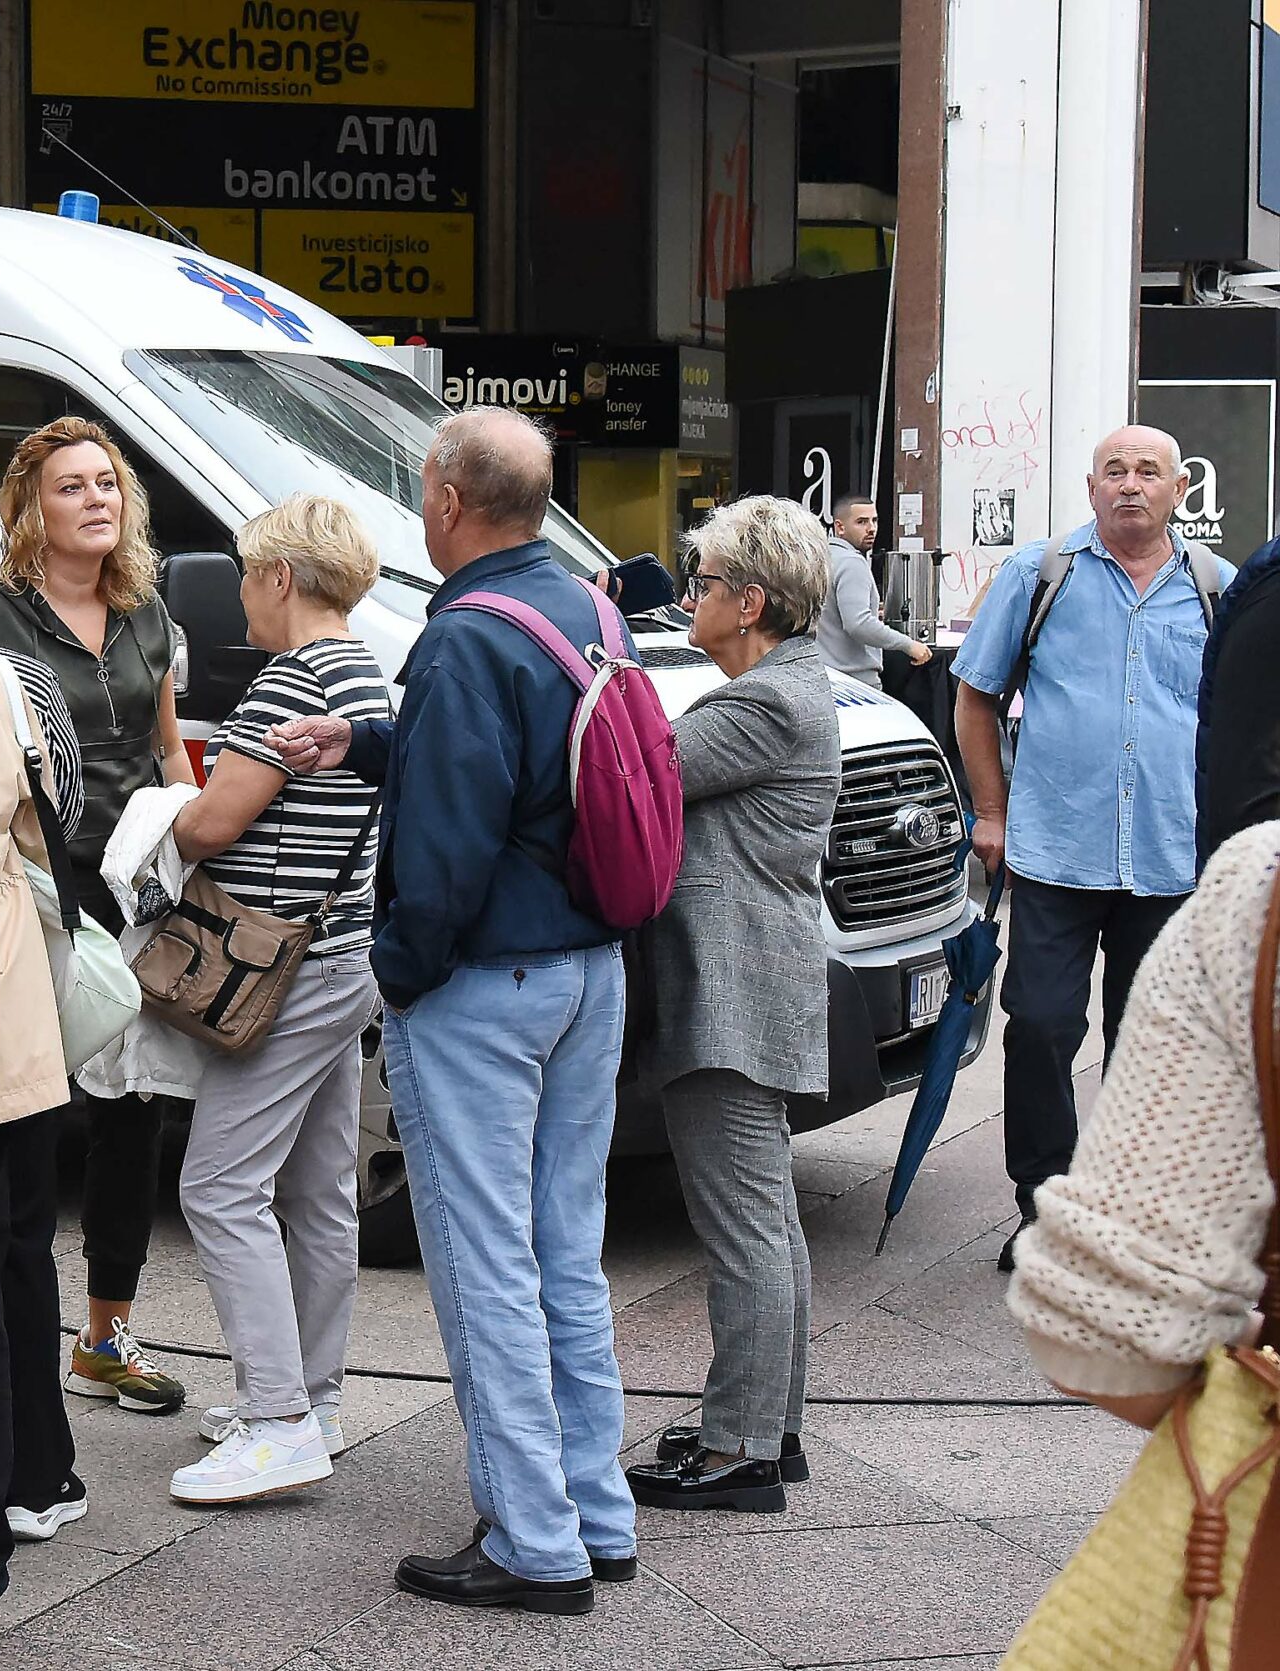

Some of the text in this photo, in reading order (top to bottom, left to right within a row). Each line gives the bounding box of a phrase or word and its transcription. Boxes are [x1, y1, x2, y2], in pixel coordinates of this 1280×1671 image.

[242, 1, 361, 40] Money
[143, 27, 369, 85] Exchange
[156, 75, 312, 97] No Commission
[41, 104, 73, 118] 24/7
[337, 116, 438, 157] ATM
[225, 159, 438, 203] bankomat
[302, 234, 430, 258] Investicijsko
[319, 257, 430, 294] Zlato
